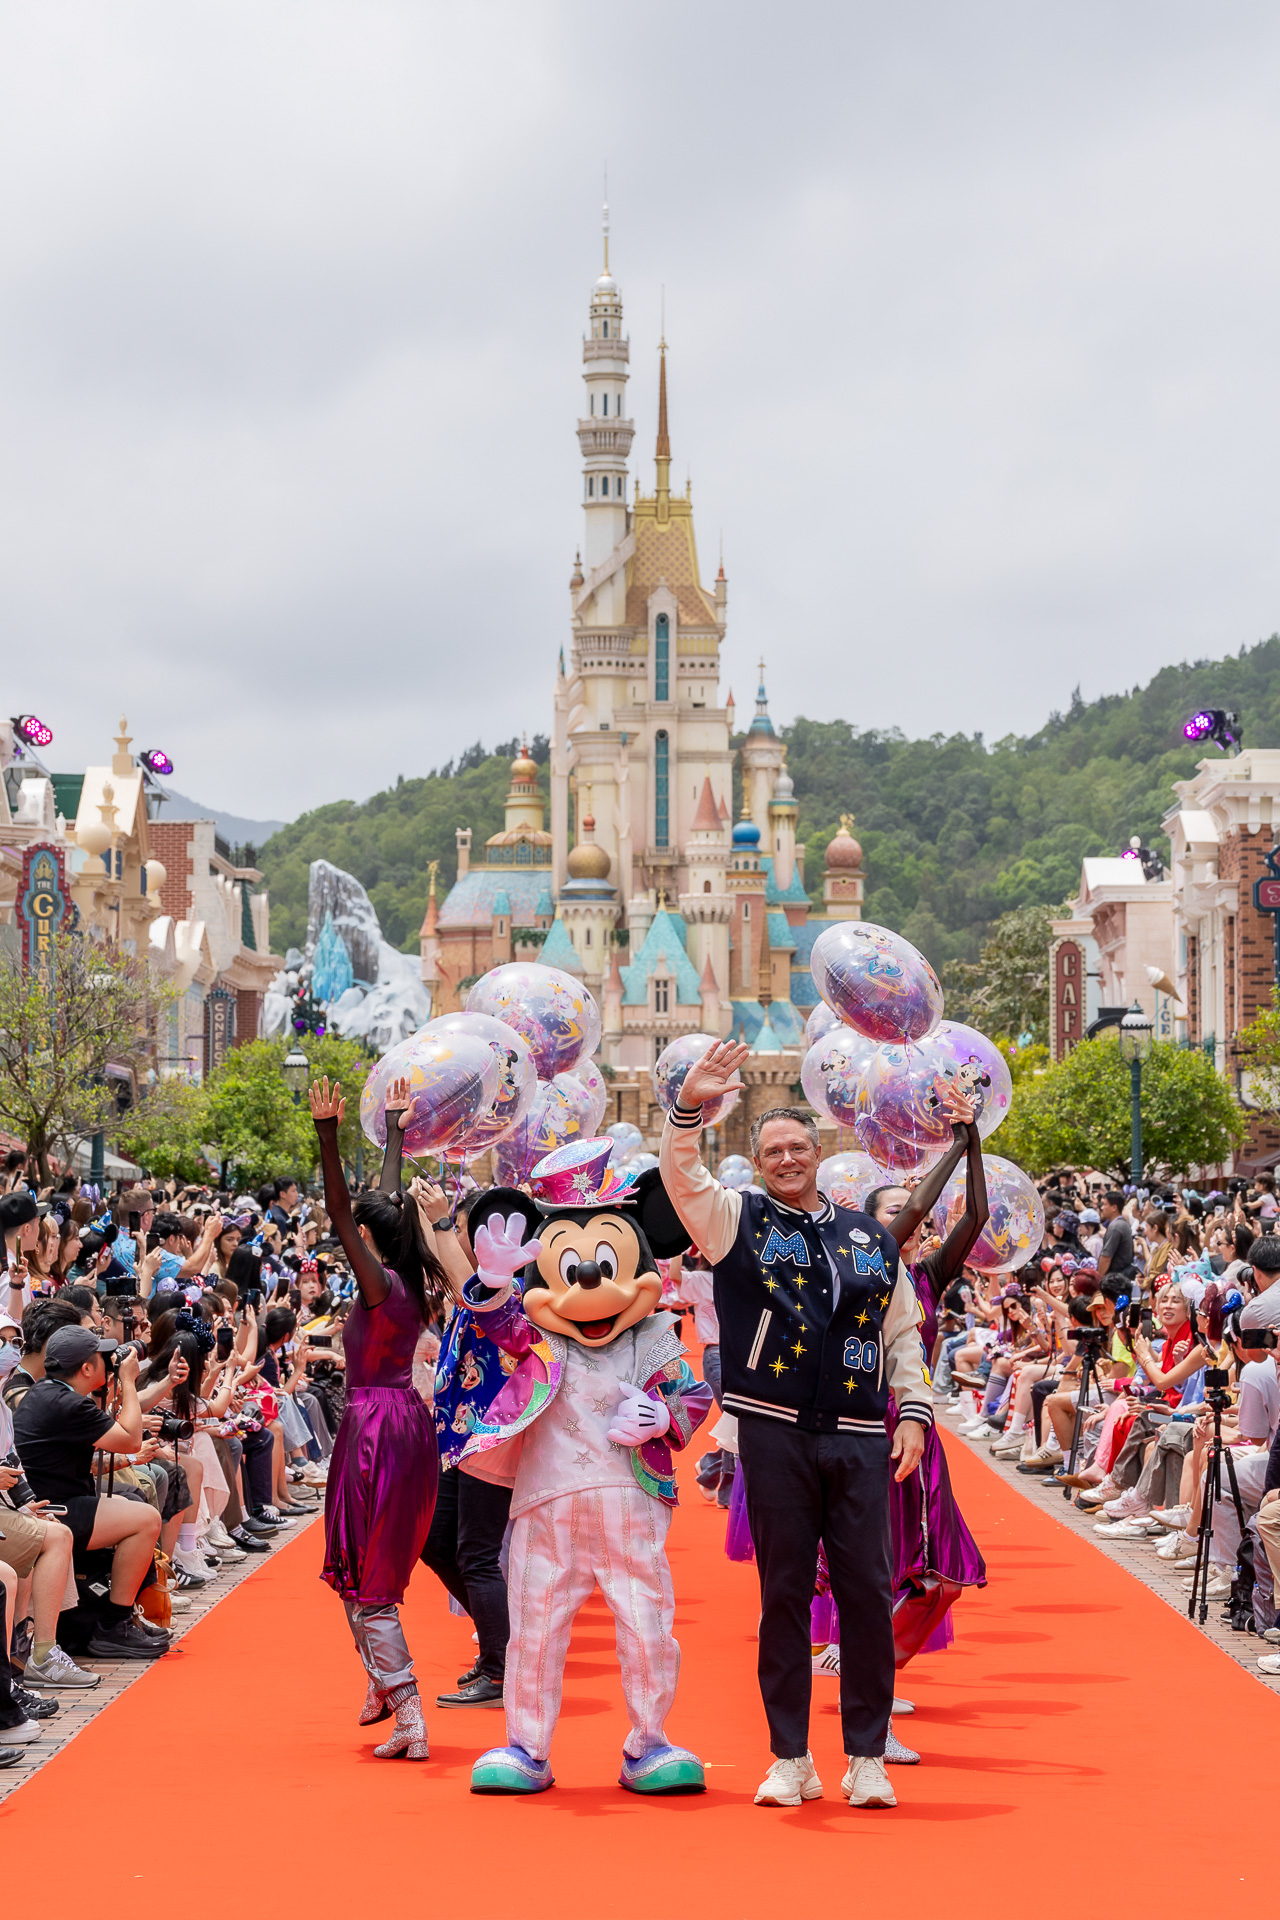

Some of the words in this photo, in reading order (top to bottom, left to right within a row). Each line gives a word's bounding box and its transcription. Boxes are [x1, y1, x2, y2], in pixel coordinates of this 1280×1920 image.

[37, 880, 51, 889] THE
[1160, 998, 1171, 1035] ICE
[760, 1226, 811, 1267] M
[851, 1245, 891, 1285] M
[843, 1336, 878, 1373] 20
[44, 1664, 67, 1682] N
